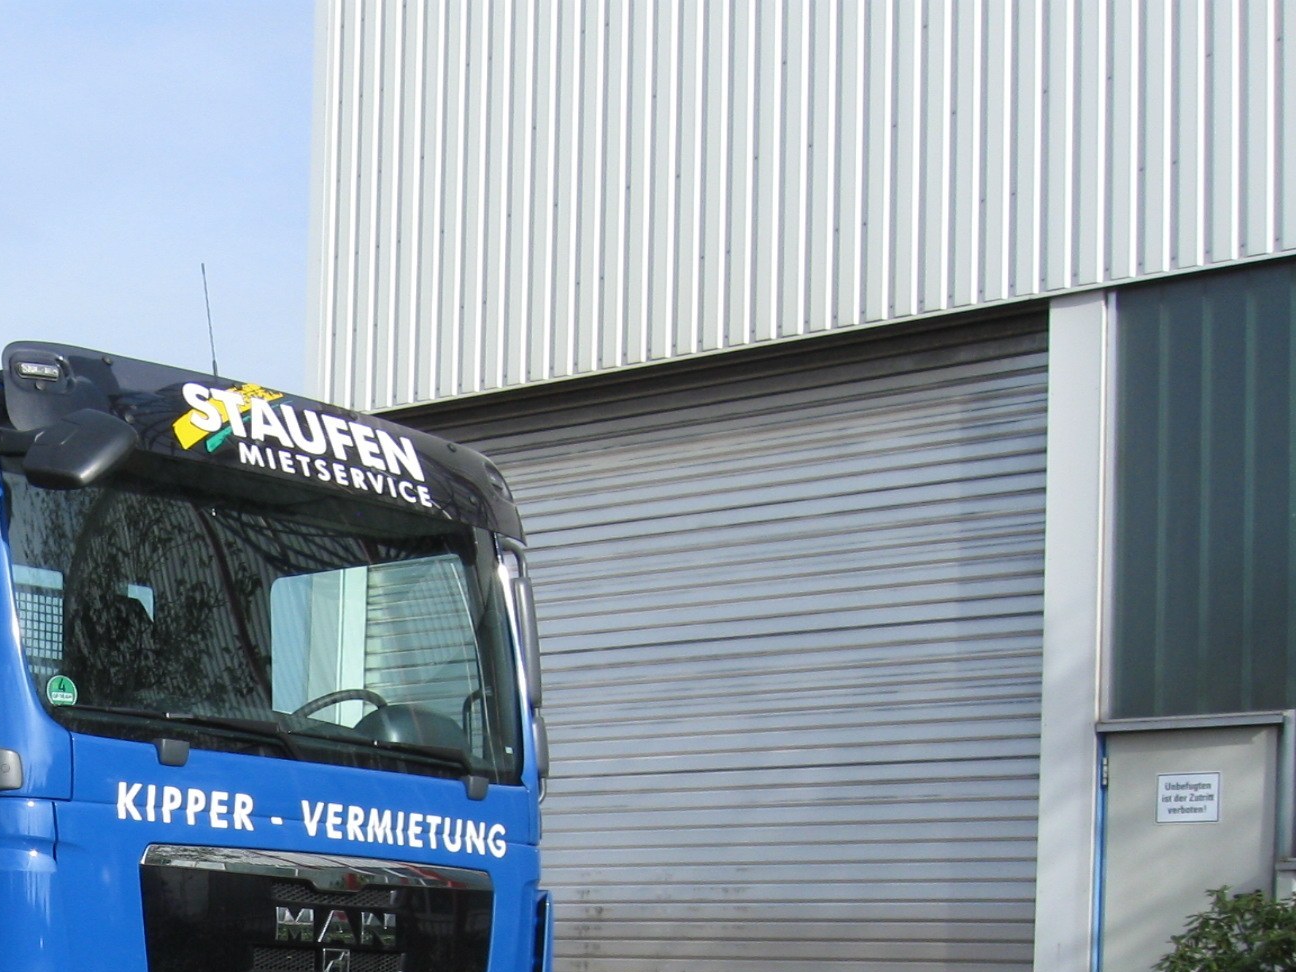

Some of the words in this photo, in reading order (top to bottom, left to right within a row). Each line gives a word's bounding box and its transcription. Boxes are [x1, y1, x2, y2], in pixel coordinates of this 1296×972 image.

[182, 382, 426, 482] STAUFEN
[238, 441, 432, 508] MIETSERVICE
[57, 678, 66, 692] 4
[1161, 794, 1172, 802] ist
[1173, 794, 1187, 802] der
[1189, 793, 1215, 802] Zutritt
[1164, 782, 1212, 792] Unbefugten
[116, 781, 255, 832] KIPPER
[301, 799, 507, 859] VERMIETUNG
[1167, 804, 1207, 814] verboten!
[275, 905, 397, 947] MAN
